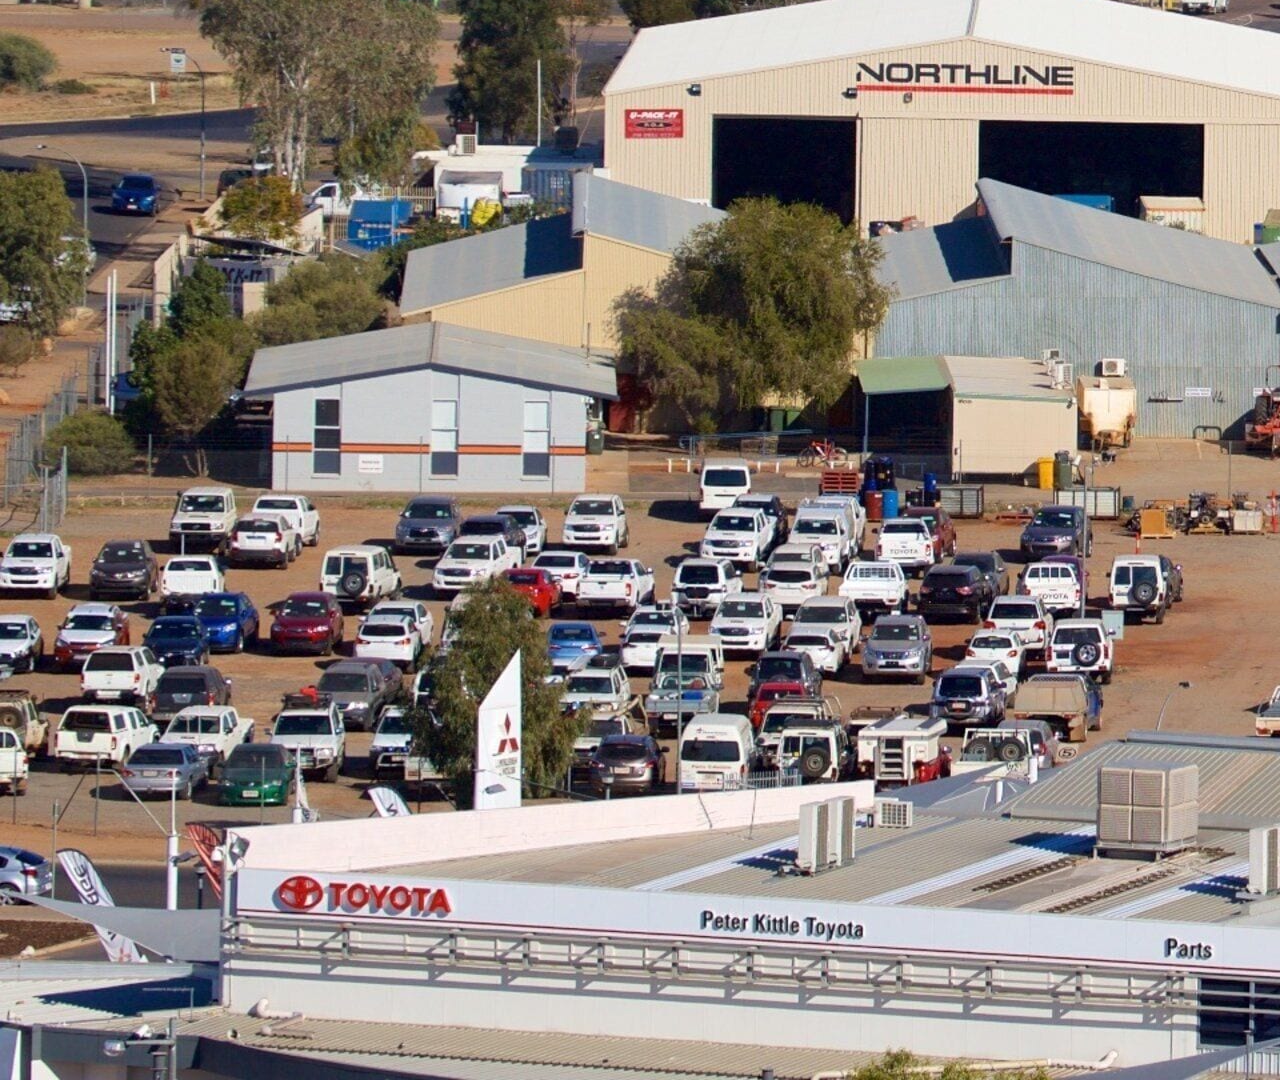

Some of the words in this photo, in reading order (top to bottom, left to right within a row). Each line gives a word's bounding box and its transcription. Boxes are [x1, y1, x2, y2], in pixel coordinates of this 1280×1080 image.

[856, 62, 1073, 86] NORTHLINE
[630, 111, 678, 119] U-PACK-IT
[329, 883, 452, 912] TOYOTA
[701, 910, 748, 930] Peter
[753, 914, 800, 934] Kittle
[805, 917, 864, 940] Toyota
[1165, 938, 1212, 960] Parts
